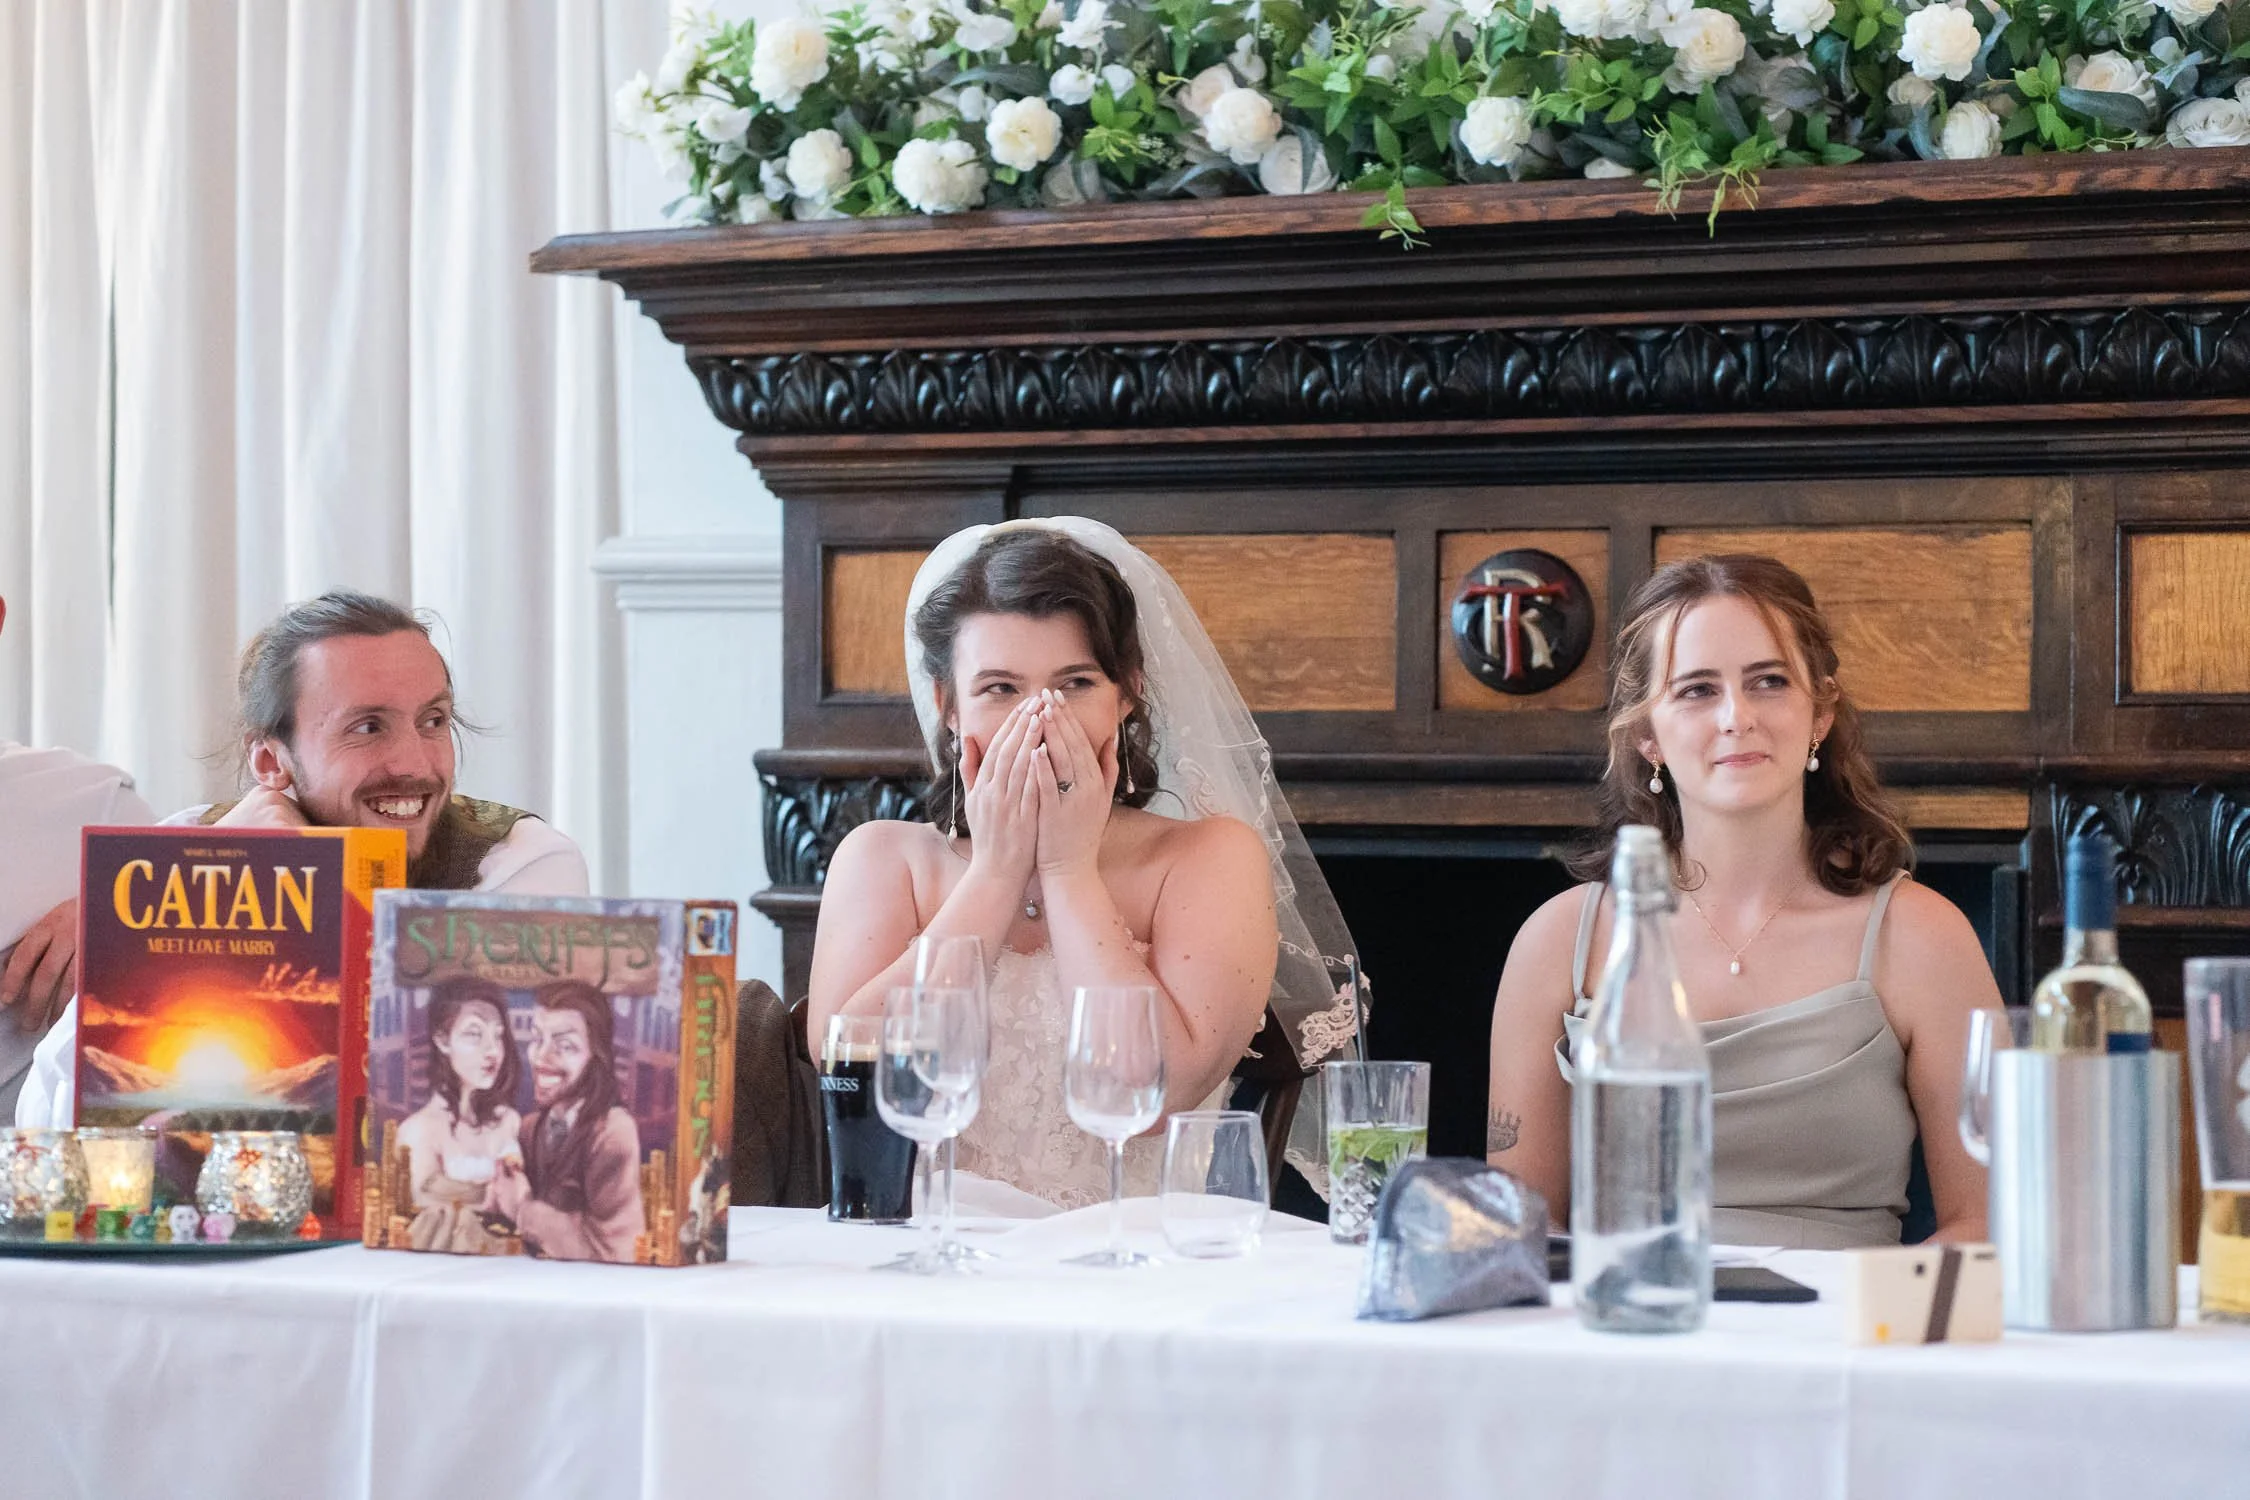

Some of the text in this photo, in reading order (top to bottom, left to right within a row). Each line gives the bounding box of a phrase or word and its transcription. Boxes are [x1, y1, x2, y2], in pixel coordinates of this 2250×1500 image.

[112, 859, 318, 933] CATAN
[147, 938, 276, 955] MEET LOVE MARRY
[820, 1076, 860, 1092] NNESS
